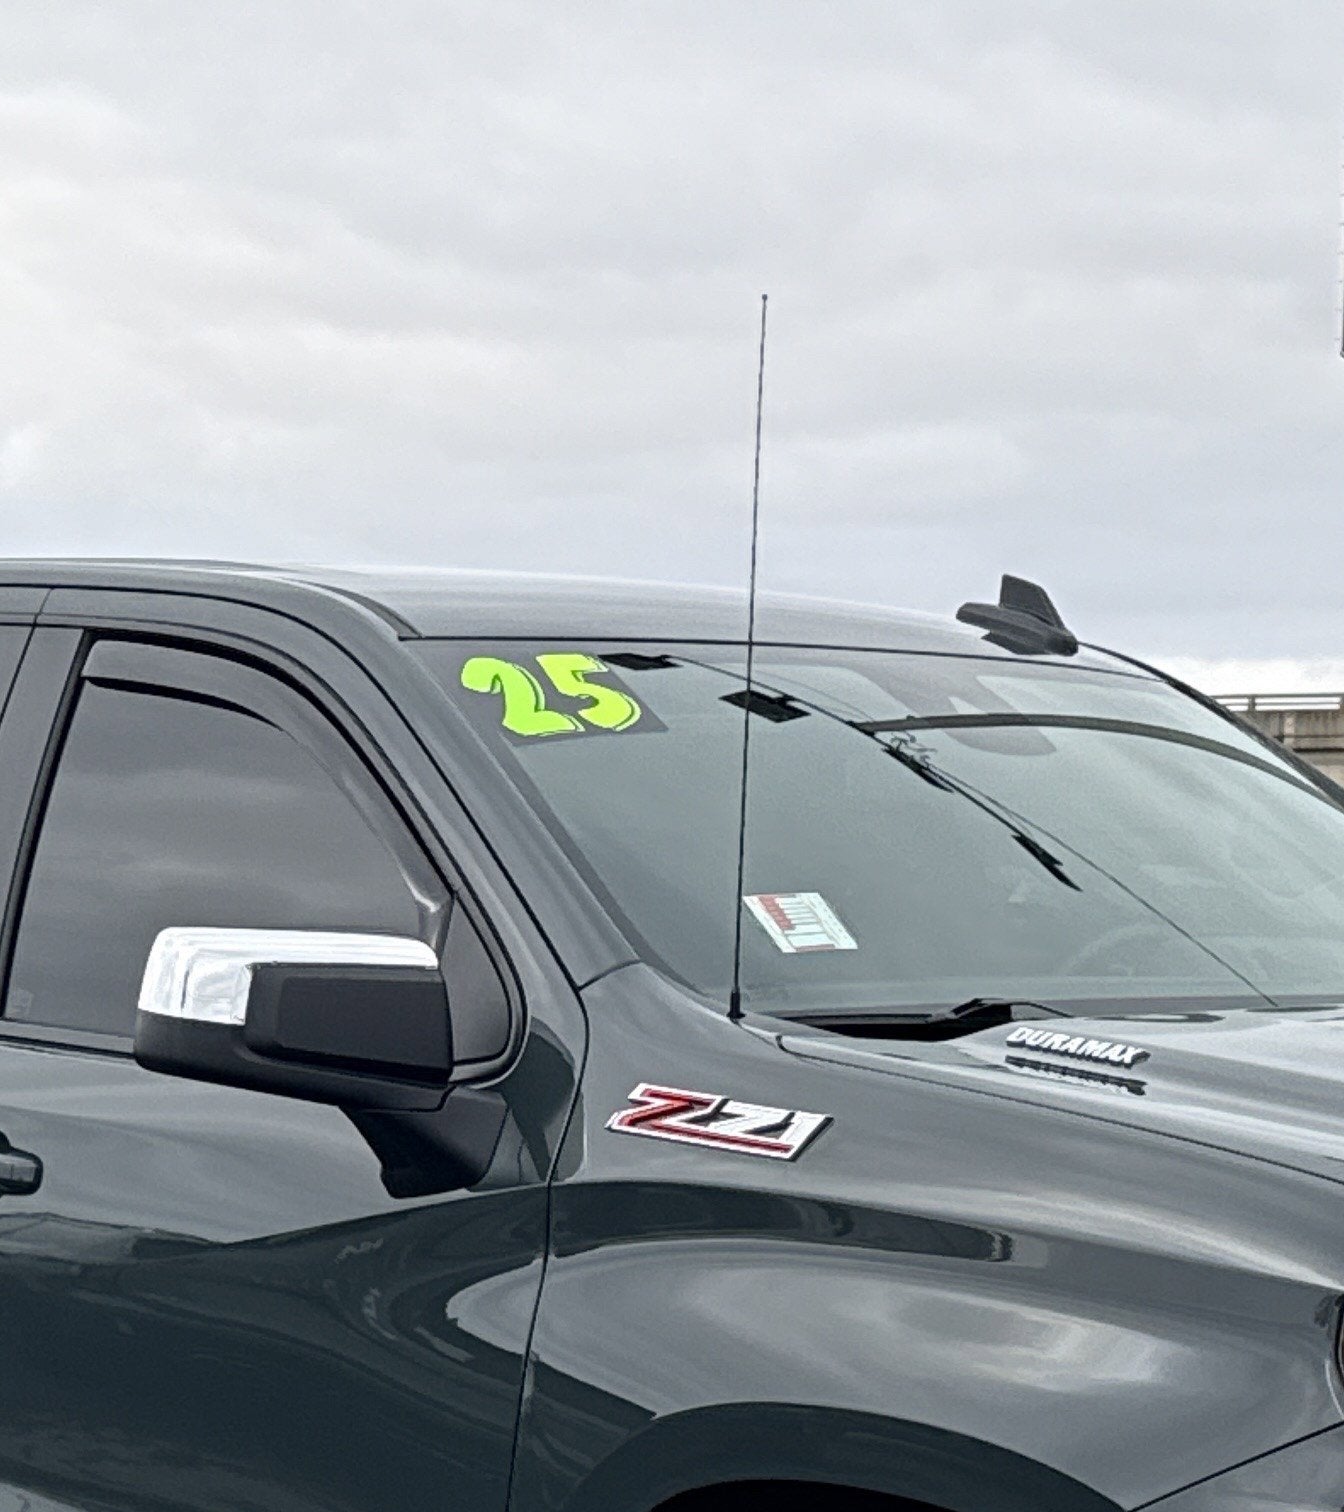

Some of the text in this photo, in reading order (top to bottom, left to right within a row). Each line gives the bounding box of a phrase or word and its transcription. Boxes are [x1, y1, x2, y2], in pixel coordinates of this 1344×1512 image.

[460, 652, 642, 736] 25
[1006, 1026, 1149, 1068] DURAMAX
[605, 1082, 833, 1161] Z71
